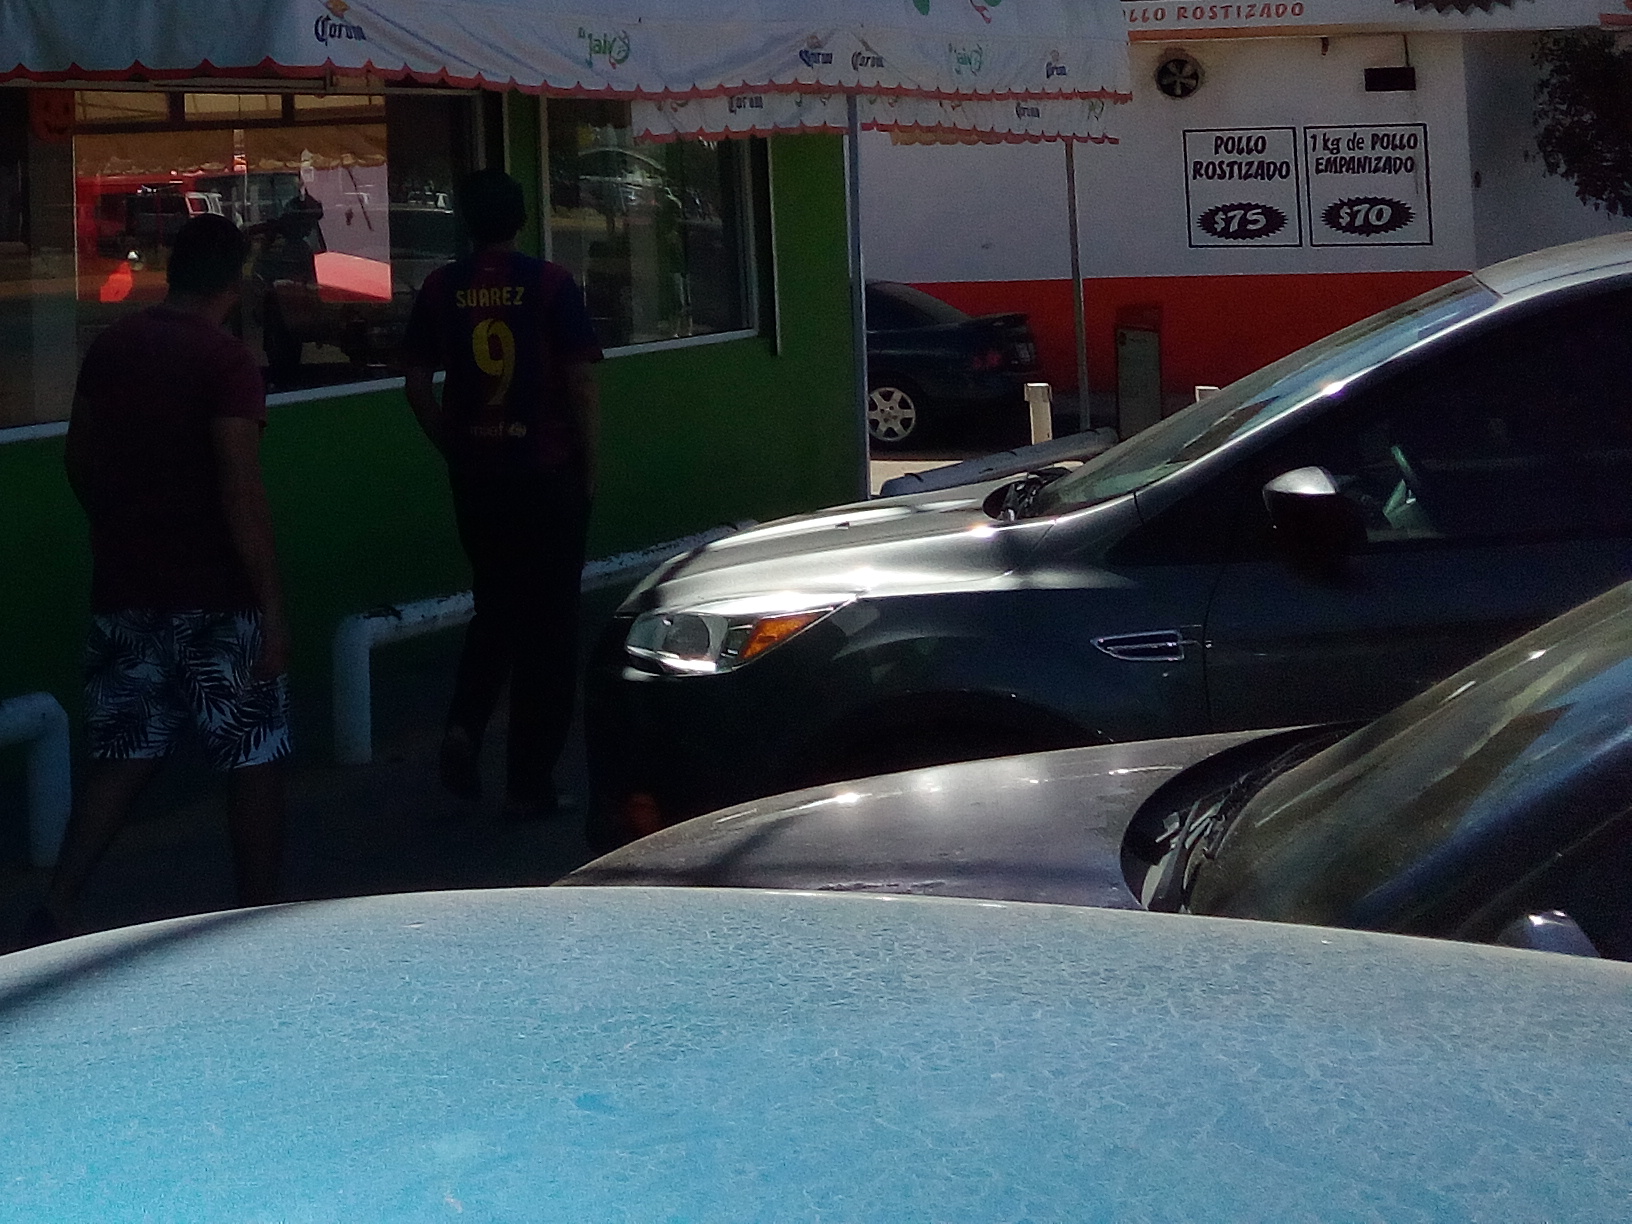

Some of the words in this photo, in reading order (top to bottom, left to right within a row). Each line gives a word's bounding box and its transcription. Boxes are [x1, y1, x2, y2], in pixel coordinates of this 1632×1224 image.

[1124, 7, 1166, 23] LLO
[1176, 2, 1305, 21] ROSTIZADO
[1214, 135, 1267, 155] POLLO
[1310, 134, 1318, 153] 1
[1322, 133, 1342, 155] kg
[1346, 132, 1365, 151] de
[1370, 132, 1418, 151] POLLO
[1192, 161, 1291, 180] ROSTIZADO
[1314, 156, 1415, 175] EMPANIZADO
[1214, 209, 1267, 232] $75
[1339, 204, 1393, 227] $70
[472, 317, 516, 406] 9
